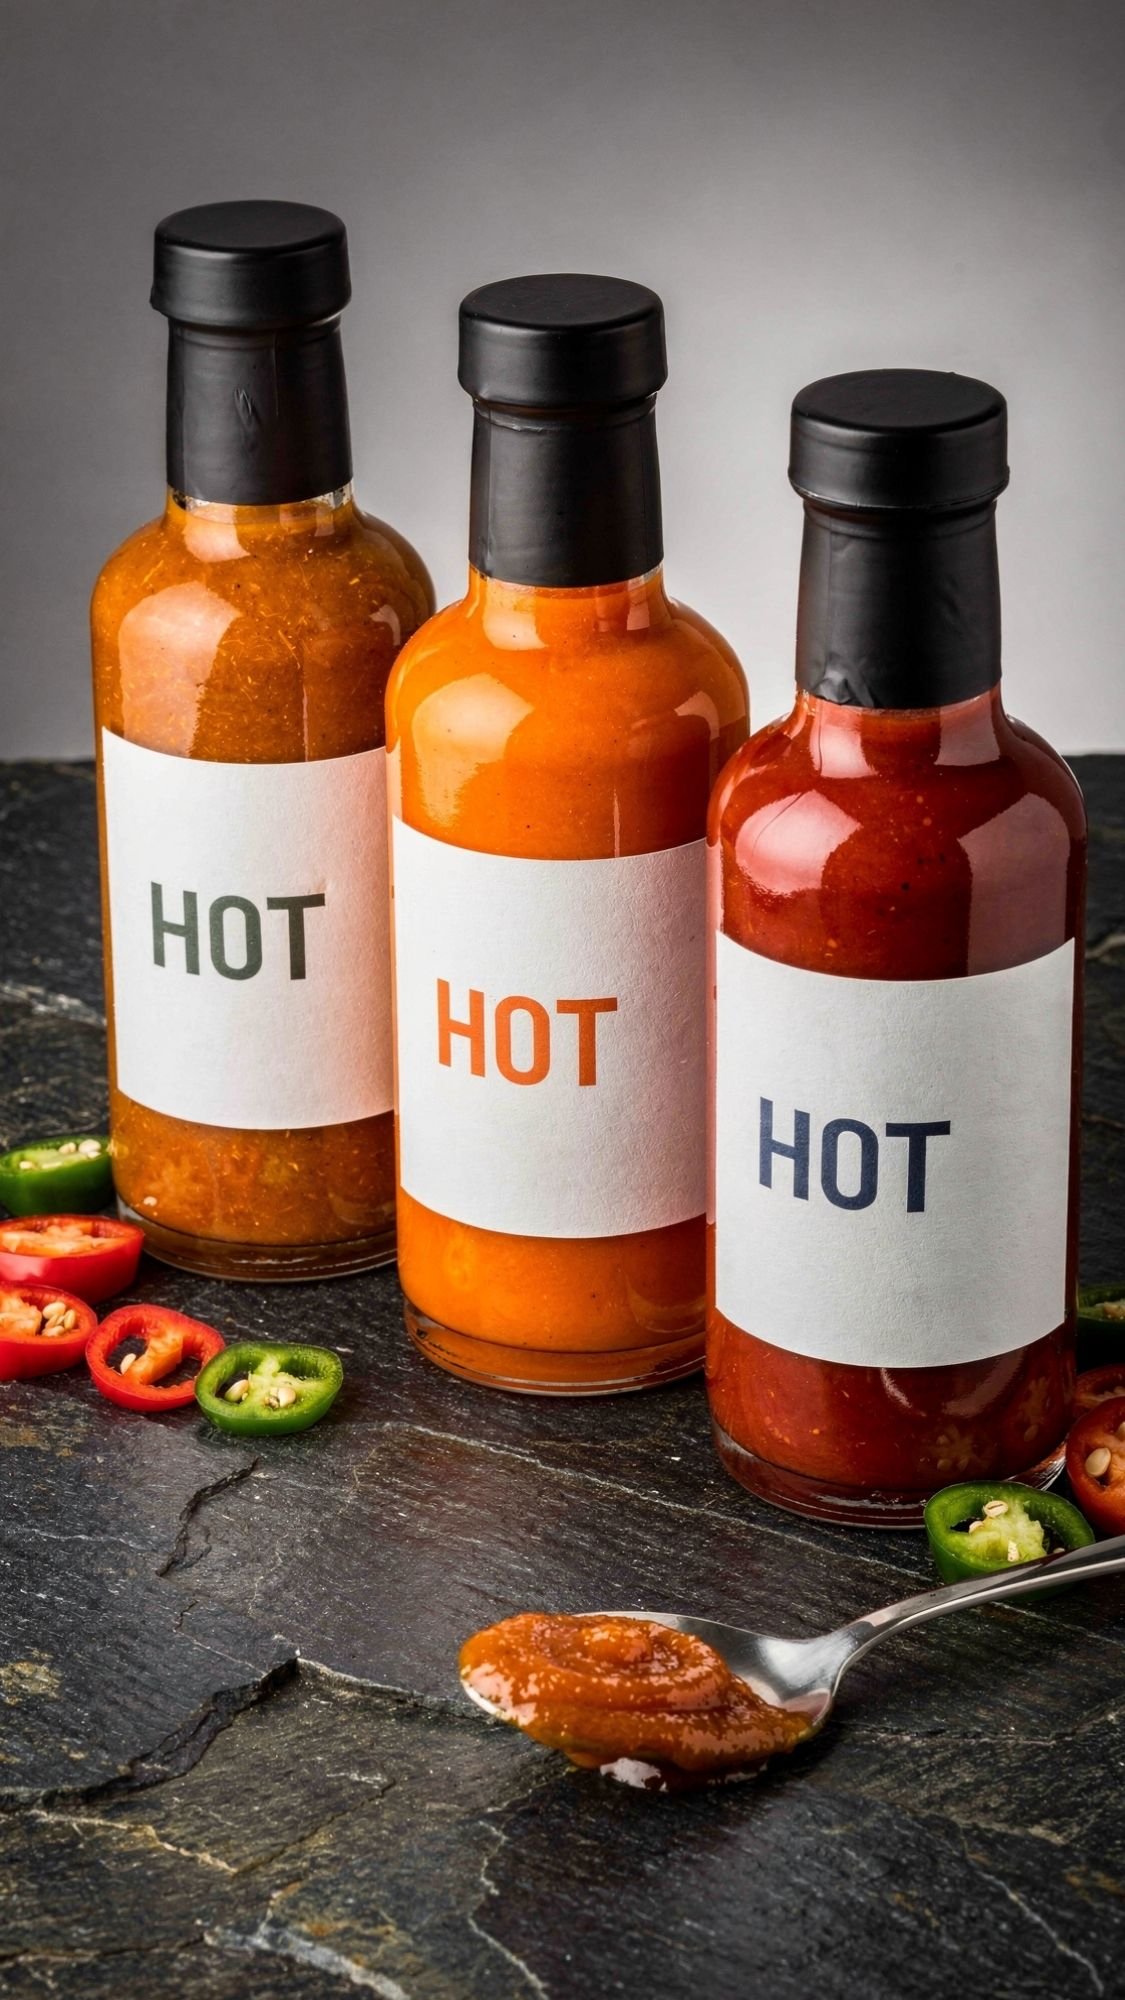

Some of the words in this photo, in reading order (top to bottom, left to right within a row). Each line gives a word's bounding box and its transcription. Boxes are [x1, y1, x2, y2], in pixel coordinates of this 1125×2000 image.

[151, 881, 326, 981] HOT
[436, 978, 618, 1087] HOT
[759, 1096, 951, 1213] HOT
